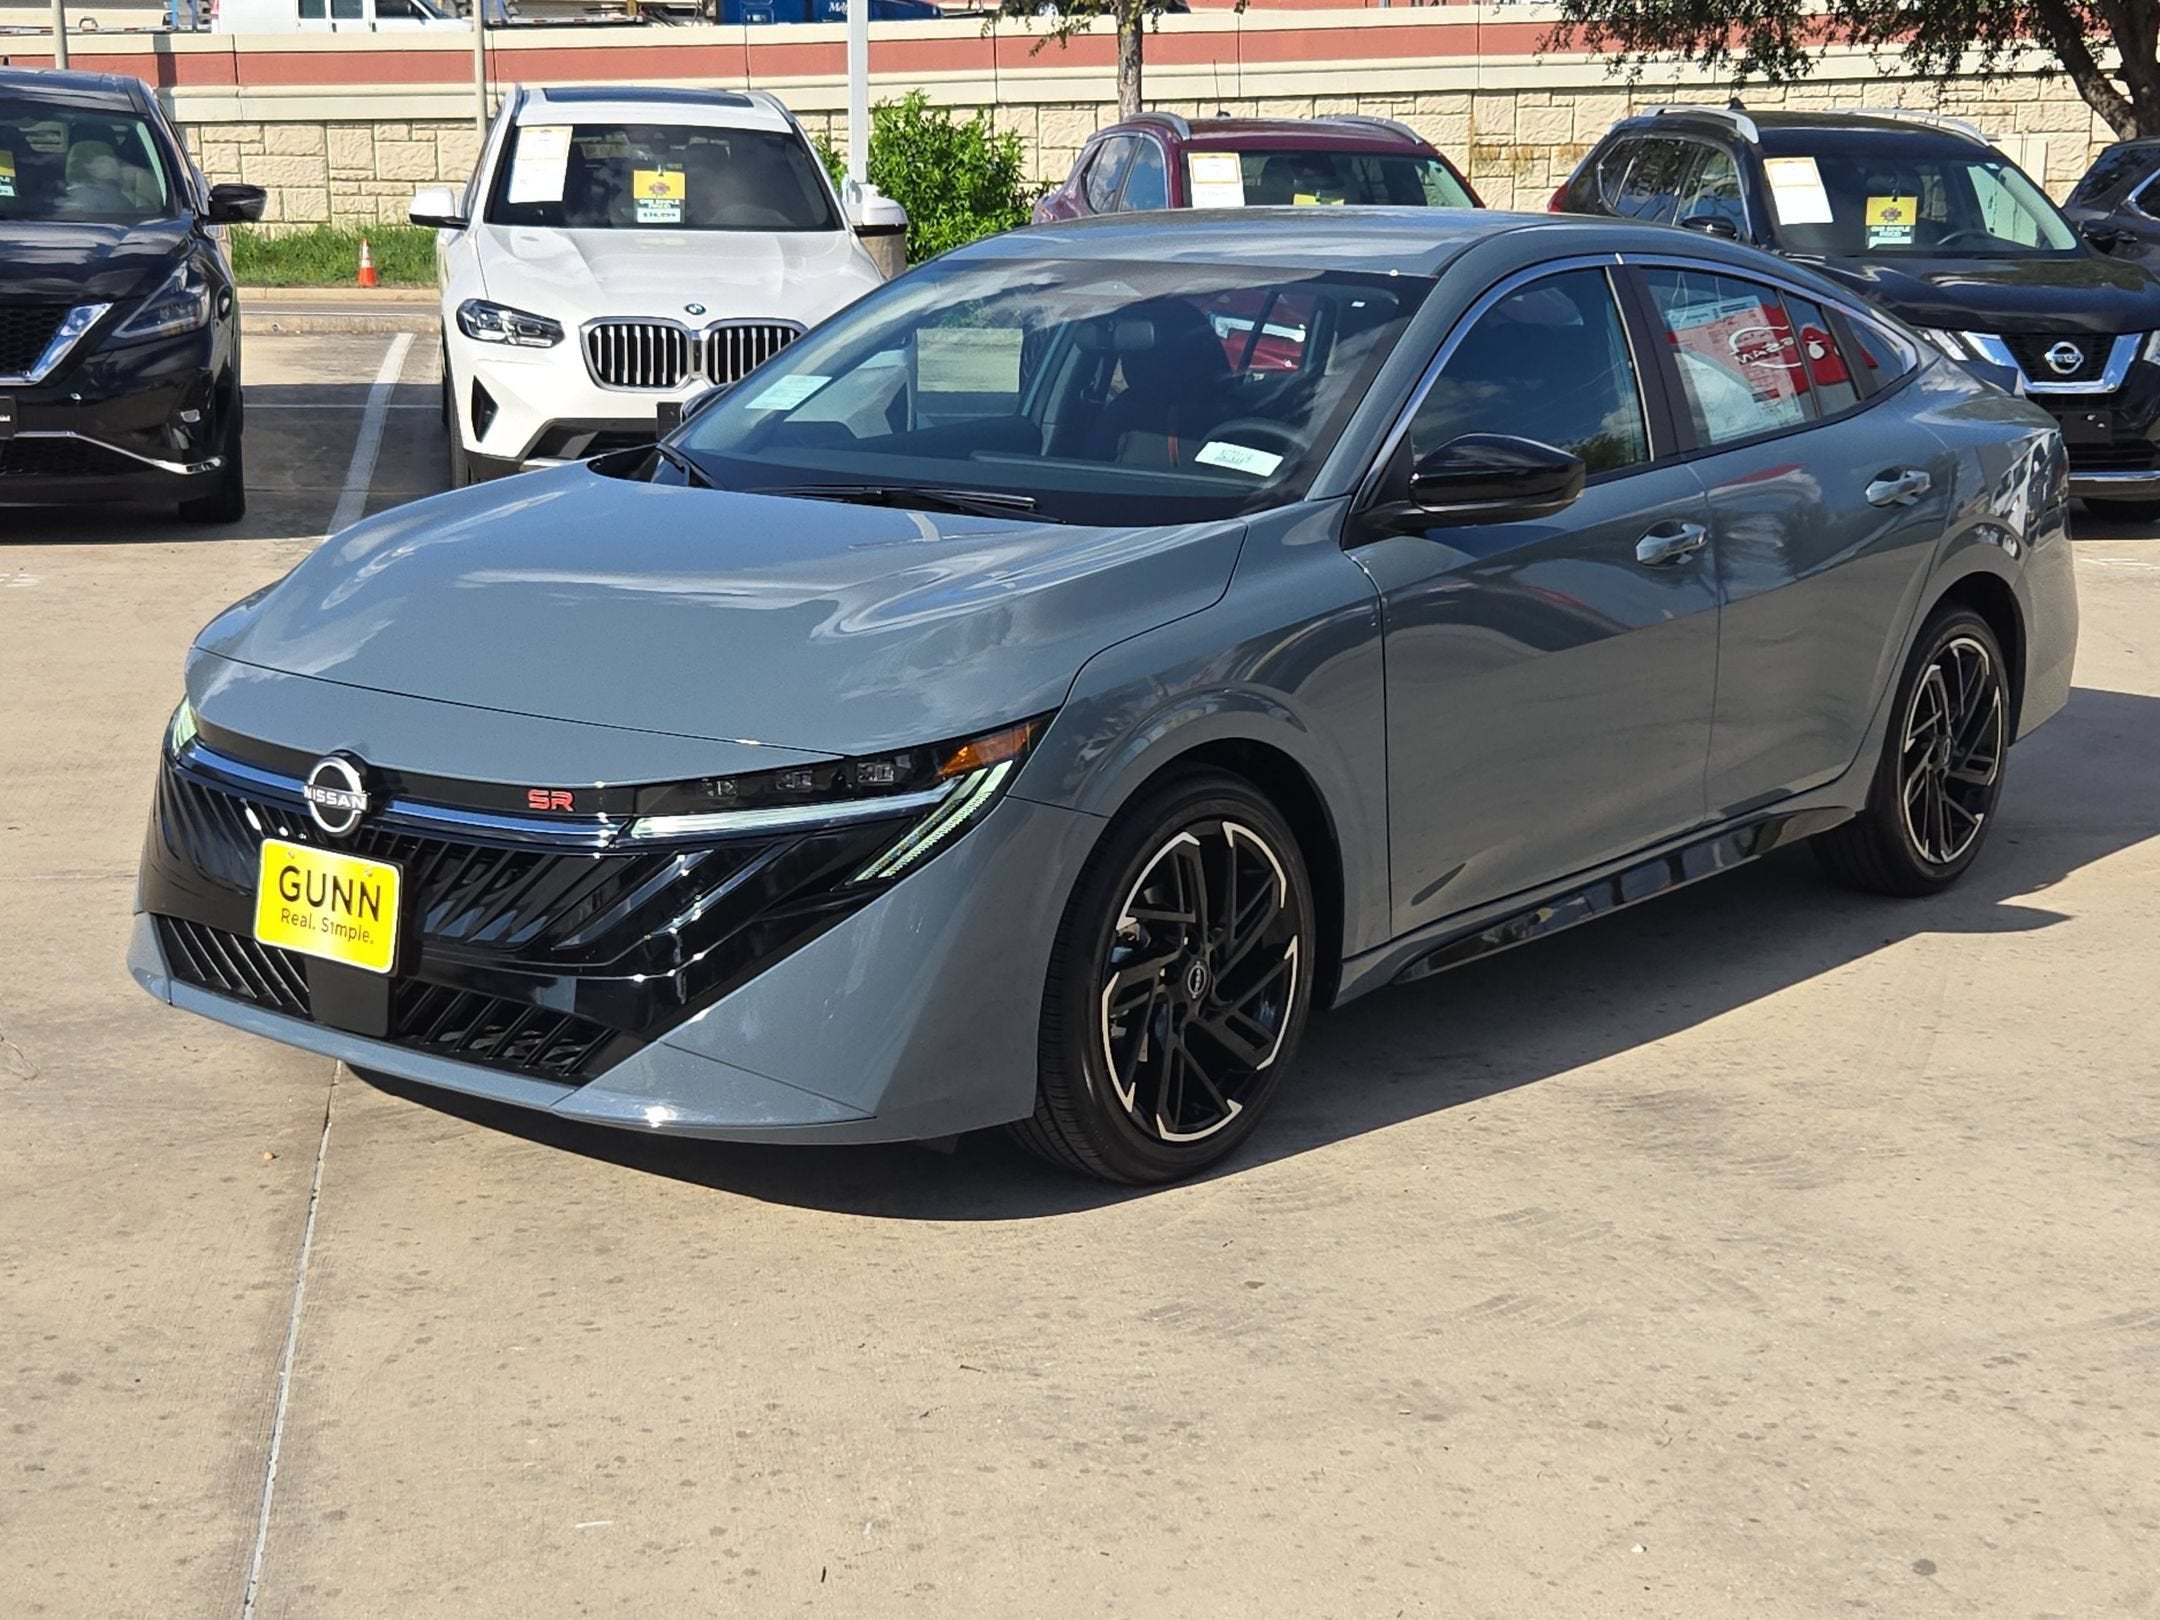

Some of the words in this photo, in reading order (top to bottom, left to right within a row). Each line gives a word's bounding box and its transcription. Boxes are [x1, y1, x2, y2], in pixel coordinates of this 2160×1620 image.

[304, 785, 367, 811] NISSAN
[528, 789, 574, 812] SR
[279, 865, 380, 922] GUNN
[280, 907, 316, 931] Real.
[321, 916, 375, 945] Simple.
